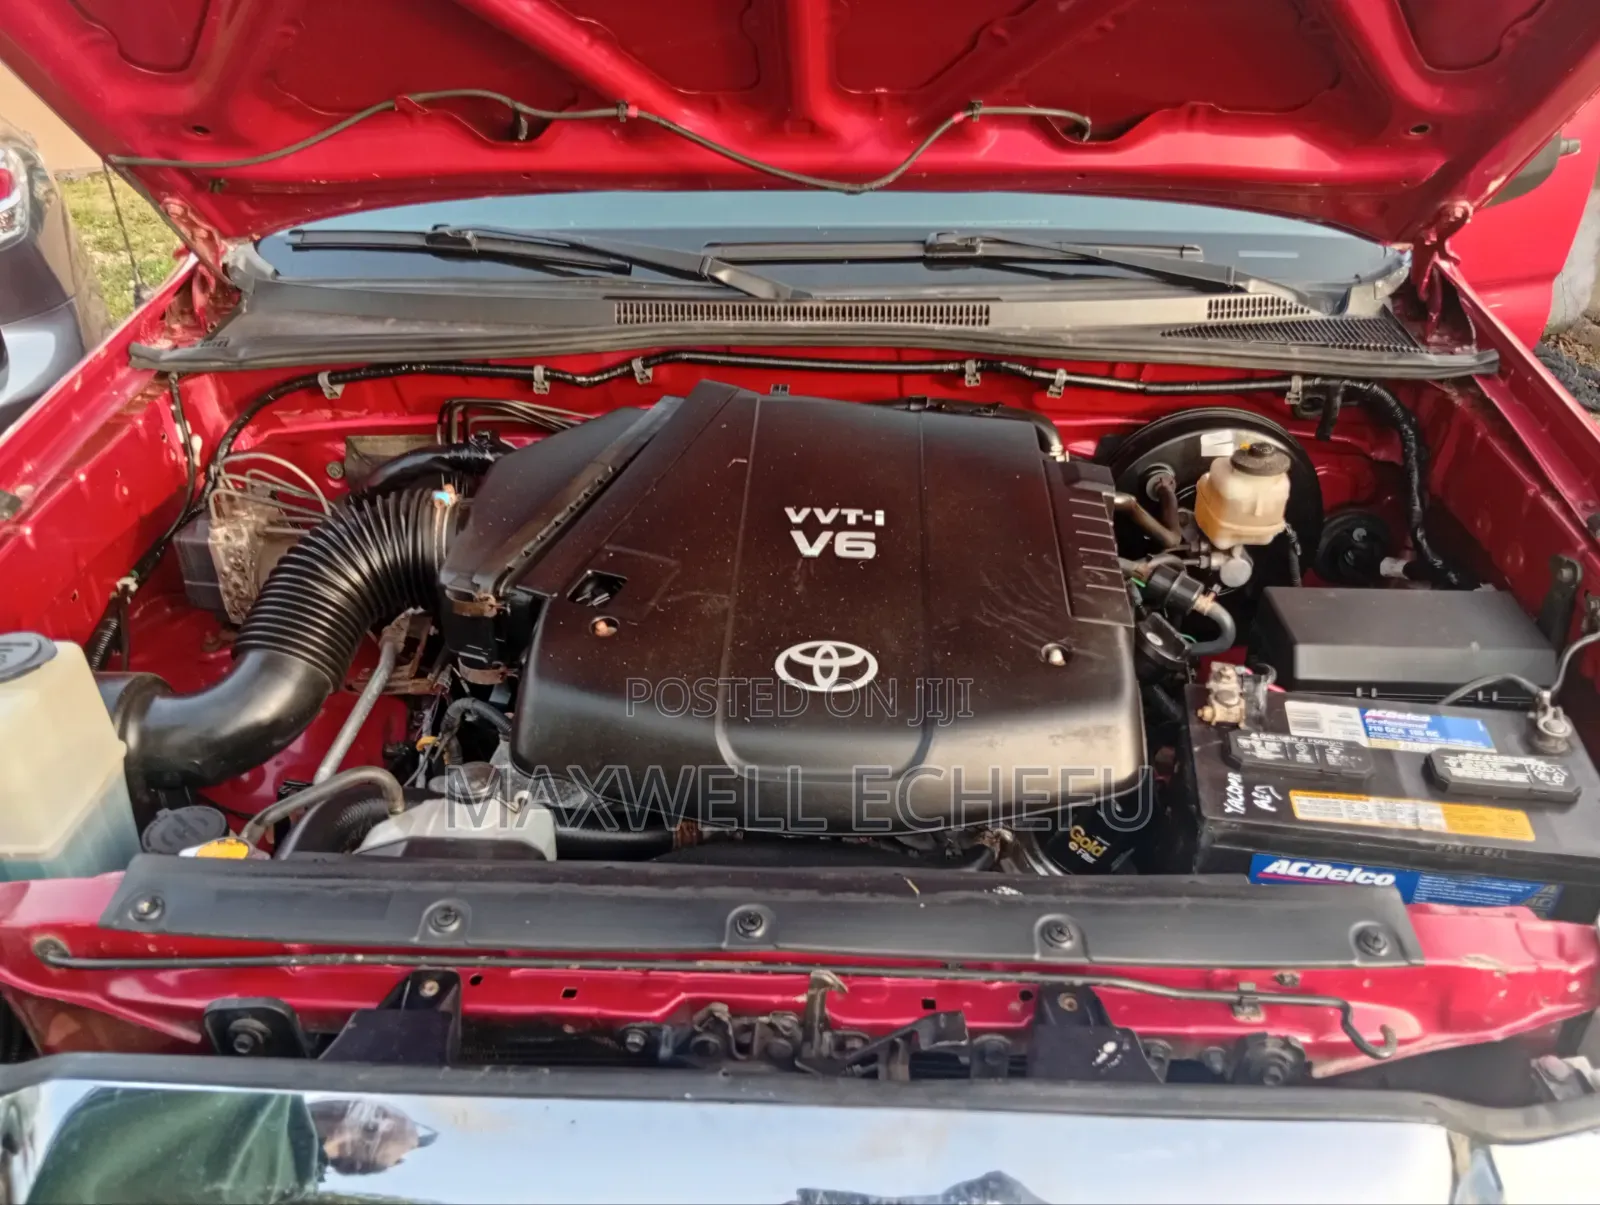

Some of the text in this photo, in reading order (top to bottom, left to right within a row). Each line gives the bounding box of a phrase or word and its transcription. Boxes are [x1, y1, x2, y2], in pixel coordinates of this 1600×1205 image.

[789, 530, 876, 559] V6
[1070, 825, 1107, 857] Gold
[1262, 859, 1396, 886] ACDelco
